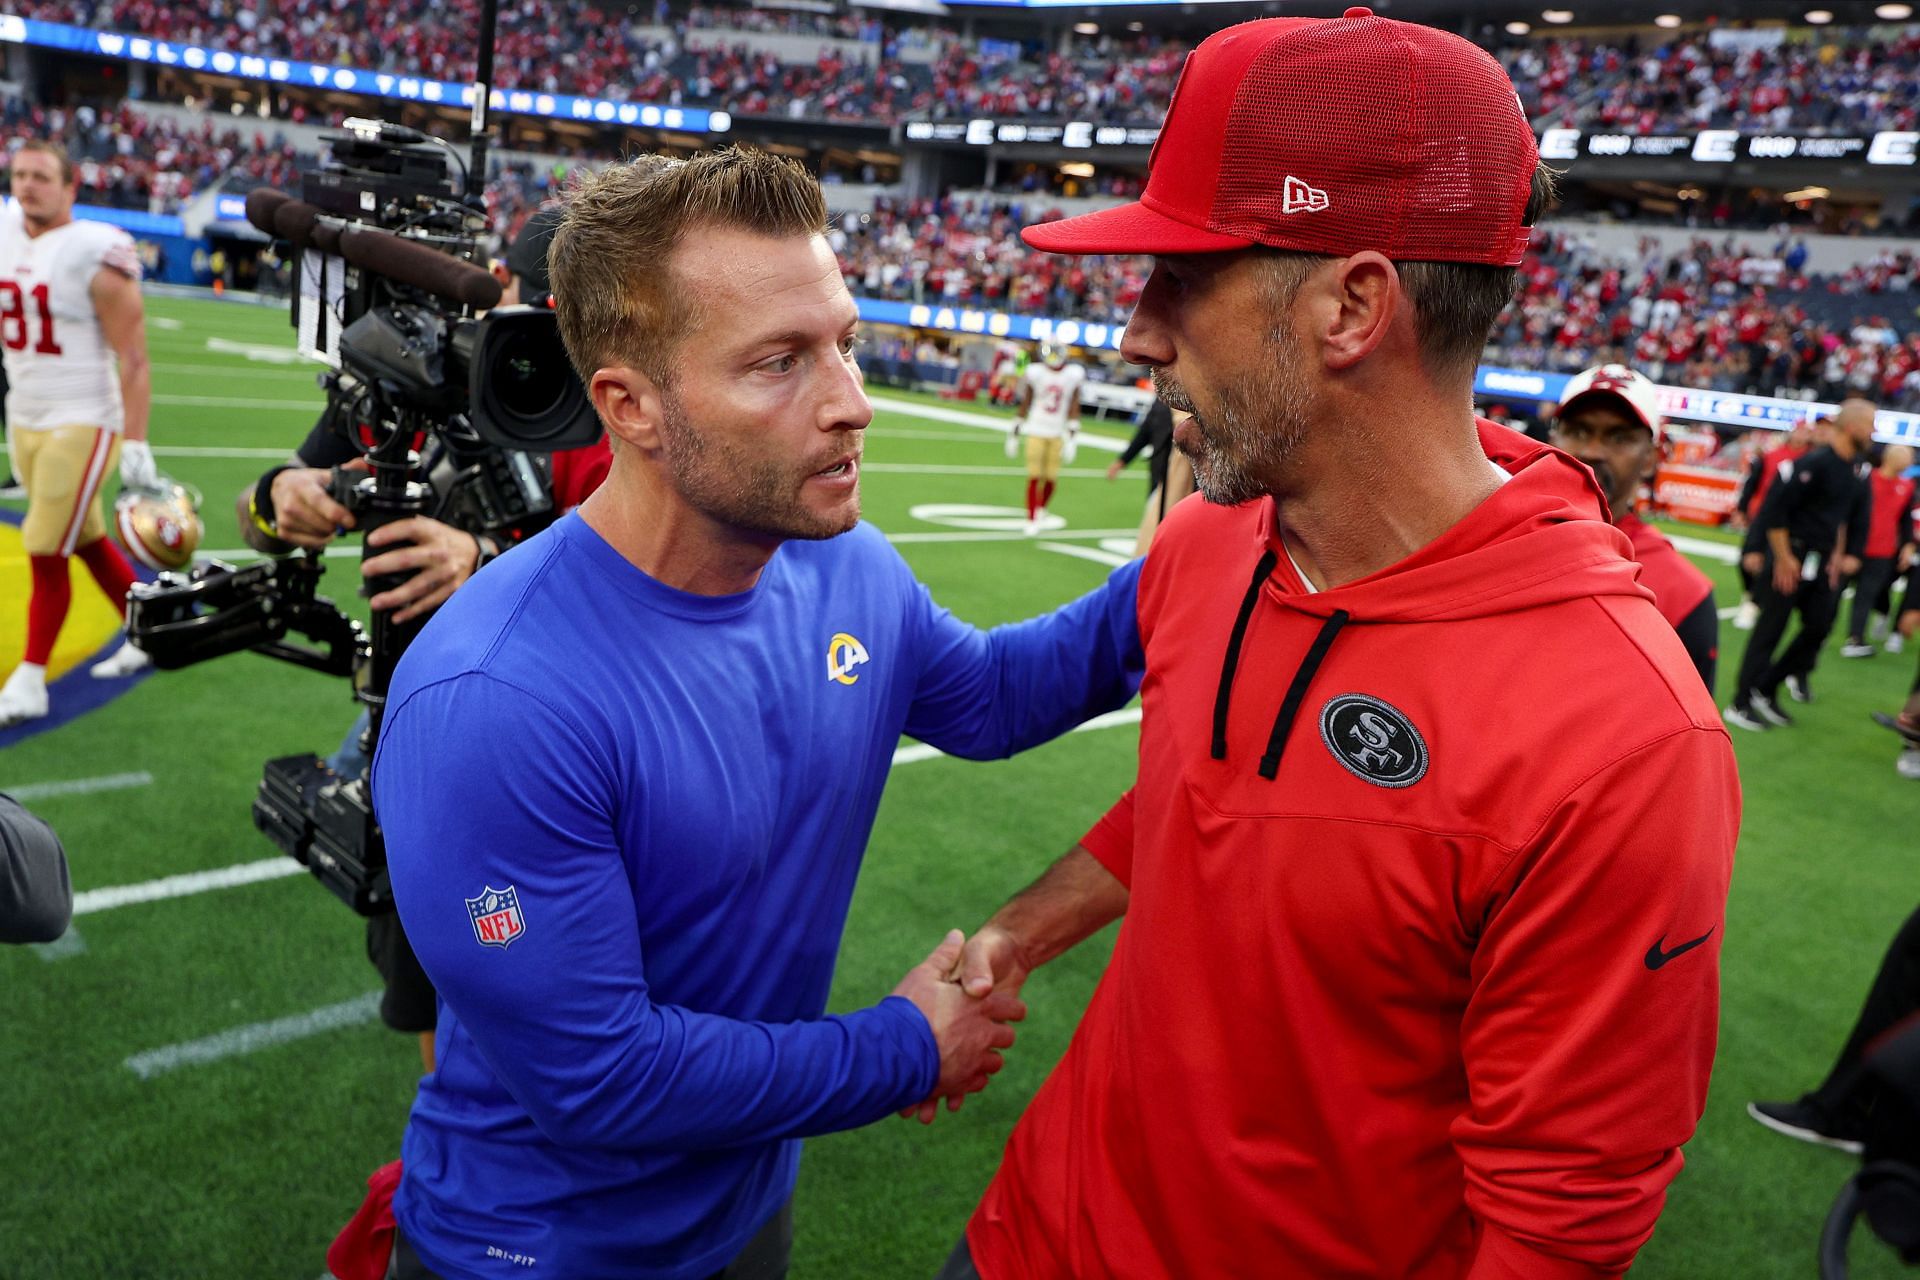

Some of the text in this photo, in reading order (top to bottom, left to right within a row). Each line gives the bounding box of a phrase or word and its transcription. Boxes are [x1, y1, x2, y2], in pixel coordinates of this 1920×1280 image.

[97, 32, 290, 81] WELCOME
[309, 65, 356, 90] TO
[375, 74, 443, 101] THE
[572, 99, 684, 128] HOUSE
[0, 279, 63, 355] 81
[909, 304, 1011, 336] RAMS
[478, 910, 521, 941] NFL
[486, 1245, 537, 1267] DRI-FIT
